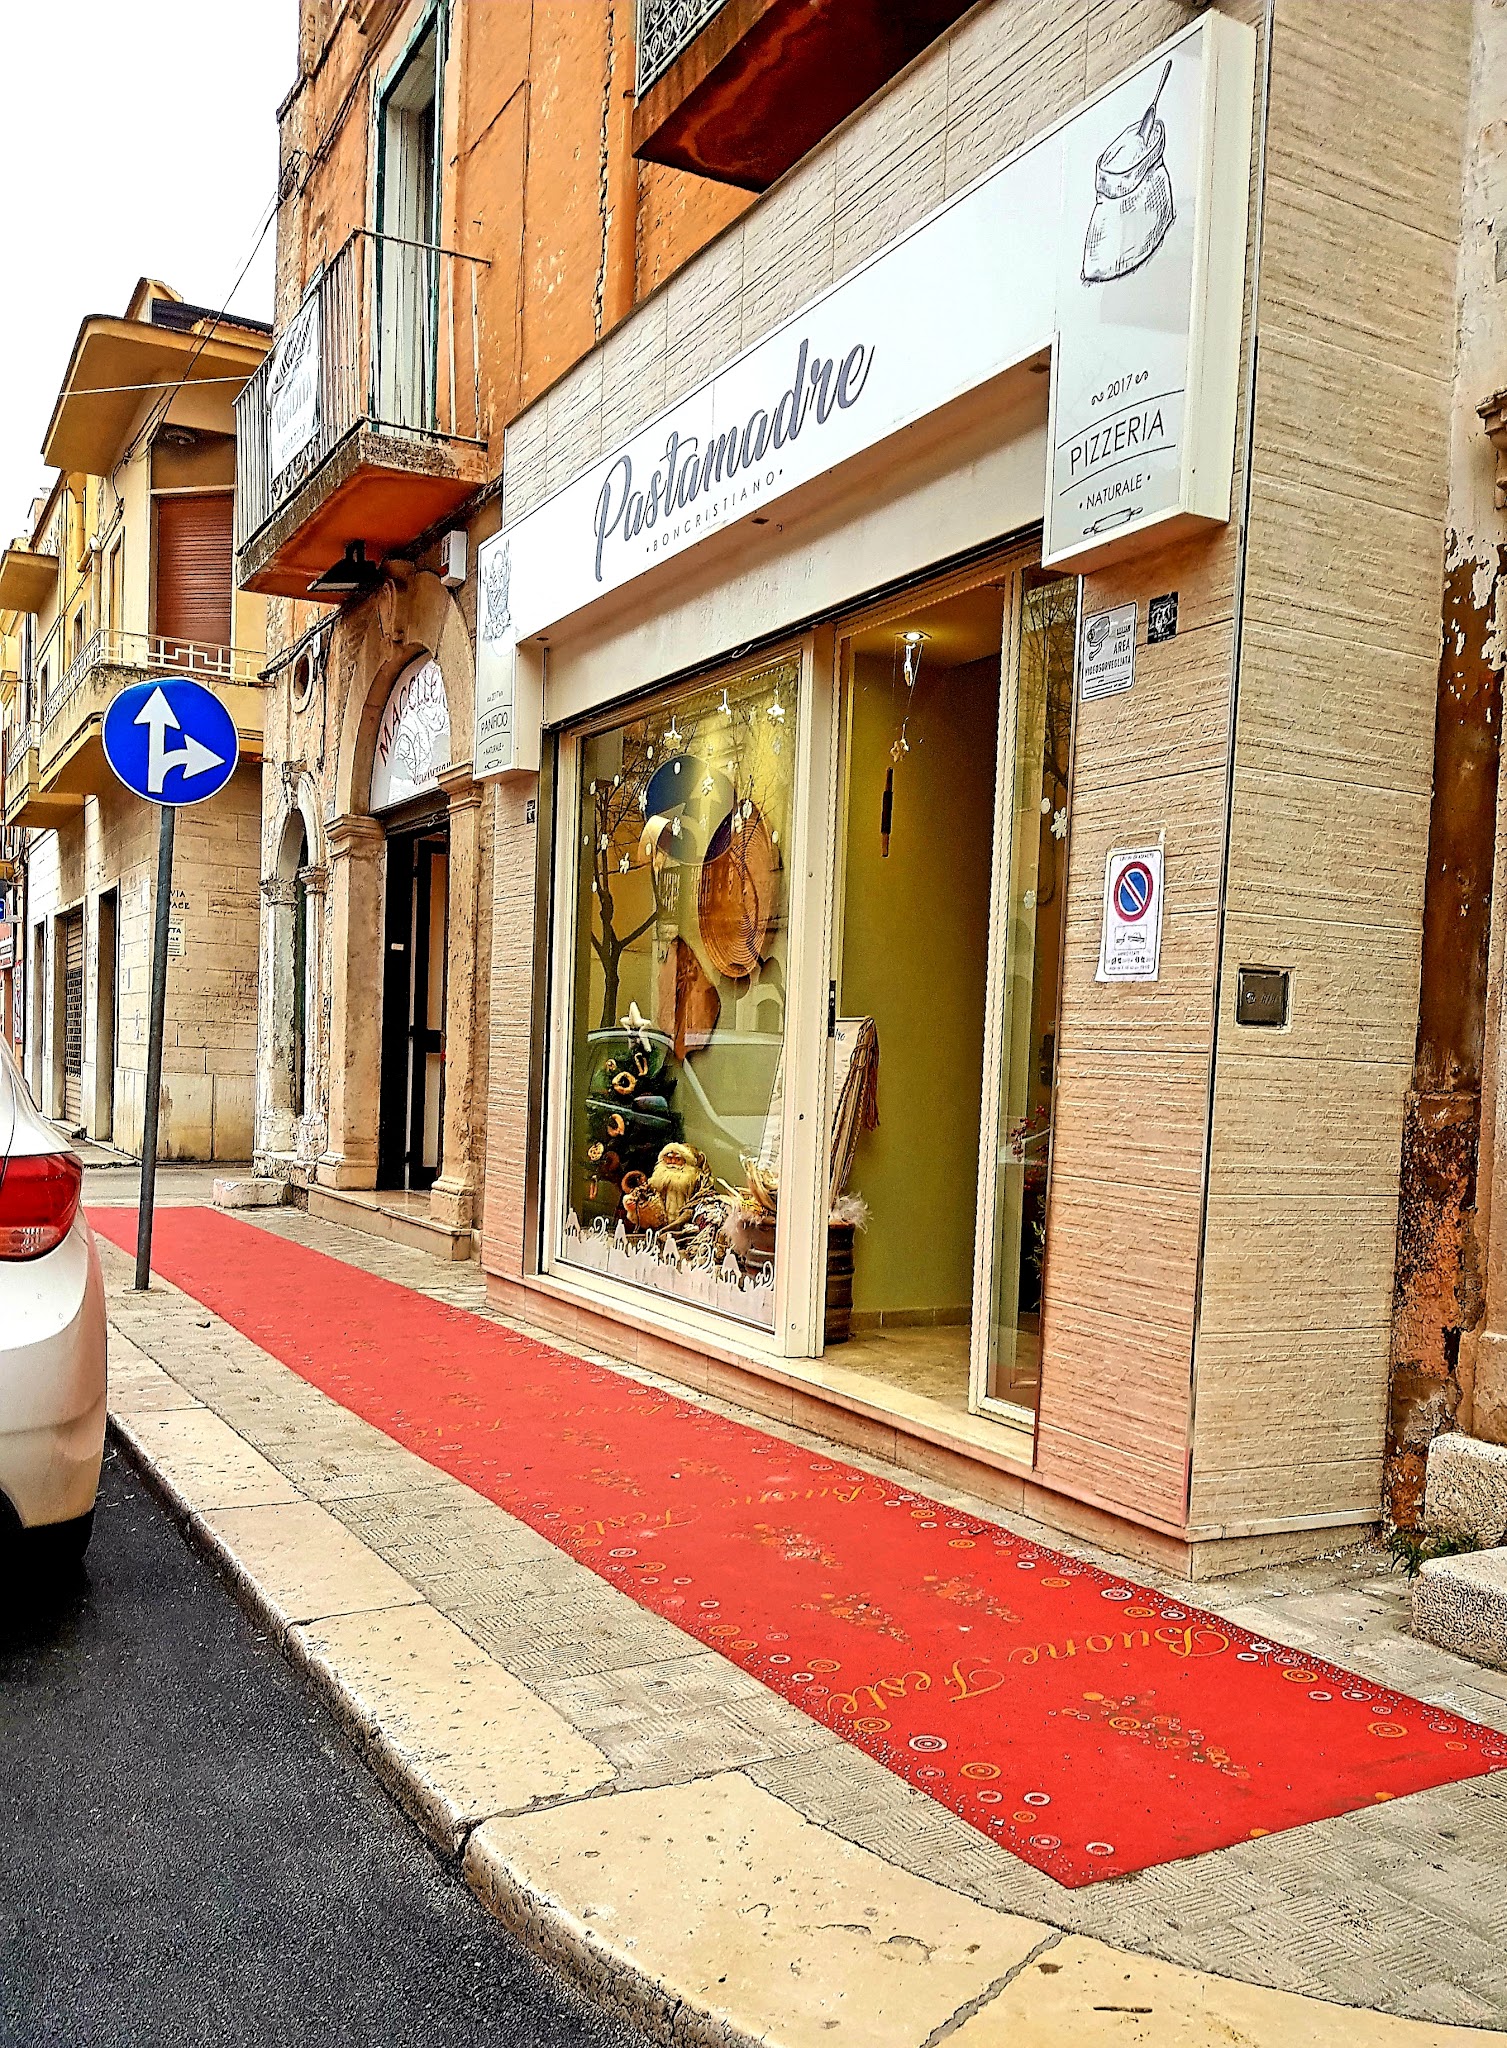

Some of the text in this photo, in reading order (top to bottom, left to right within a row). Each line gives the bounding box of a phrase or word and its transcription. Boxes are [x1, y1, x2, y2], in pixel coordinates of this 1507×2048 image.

[1107, 373, 1133, 400] 2017
[594, 338, 875, 582] Pastamadre
[1071, 408, 1164, 476] PIZZERIA
[652, 470, 775, 552] BONCRISTIANO
[1086, 473, 1143, 510] NATURALE
[1113, 638, 1131, 655] AREA
[170, 902, 190, 910] ACE
[827, 1625, 1230, 1715] Buone Feste
